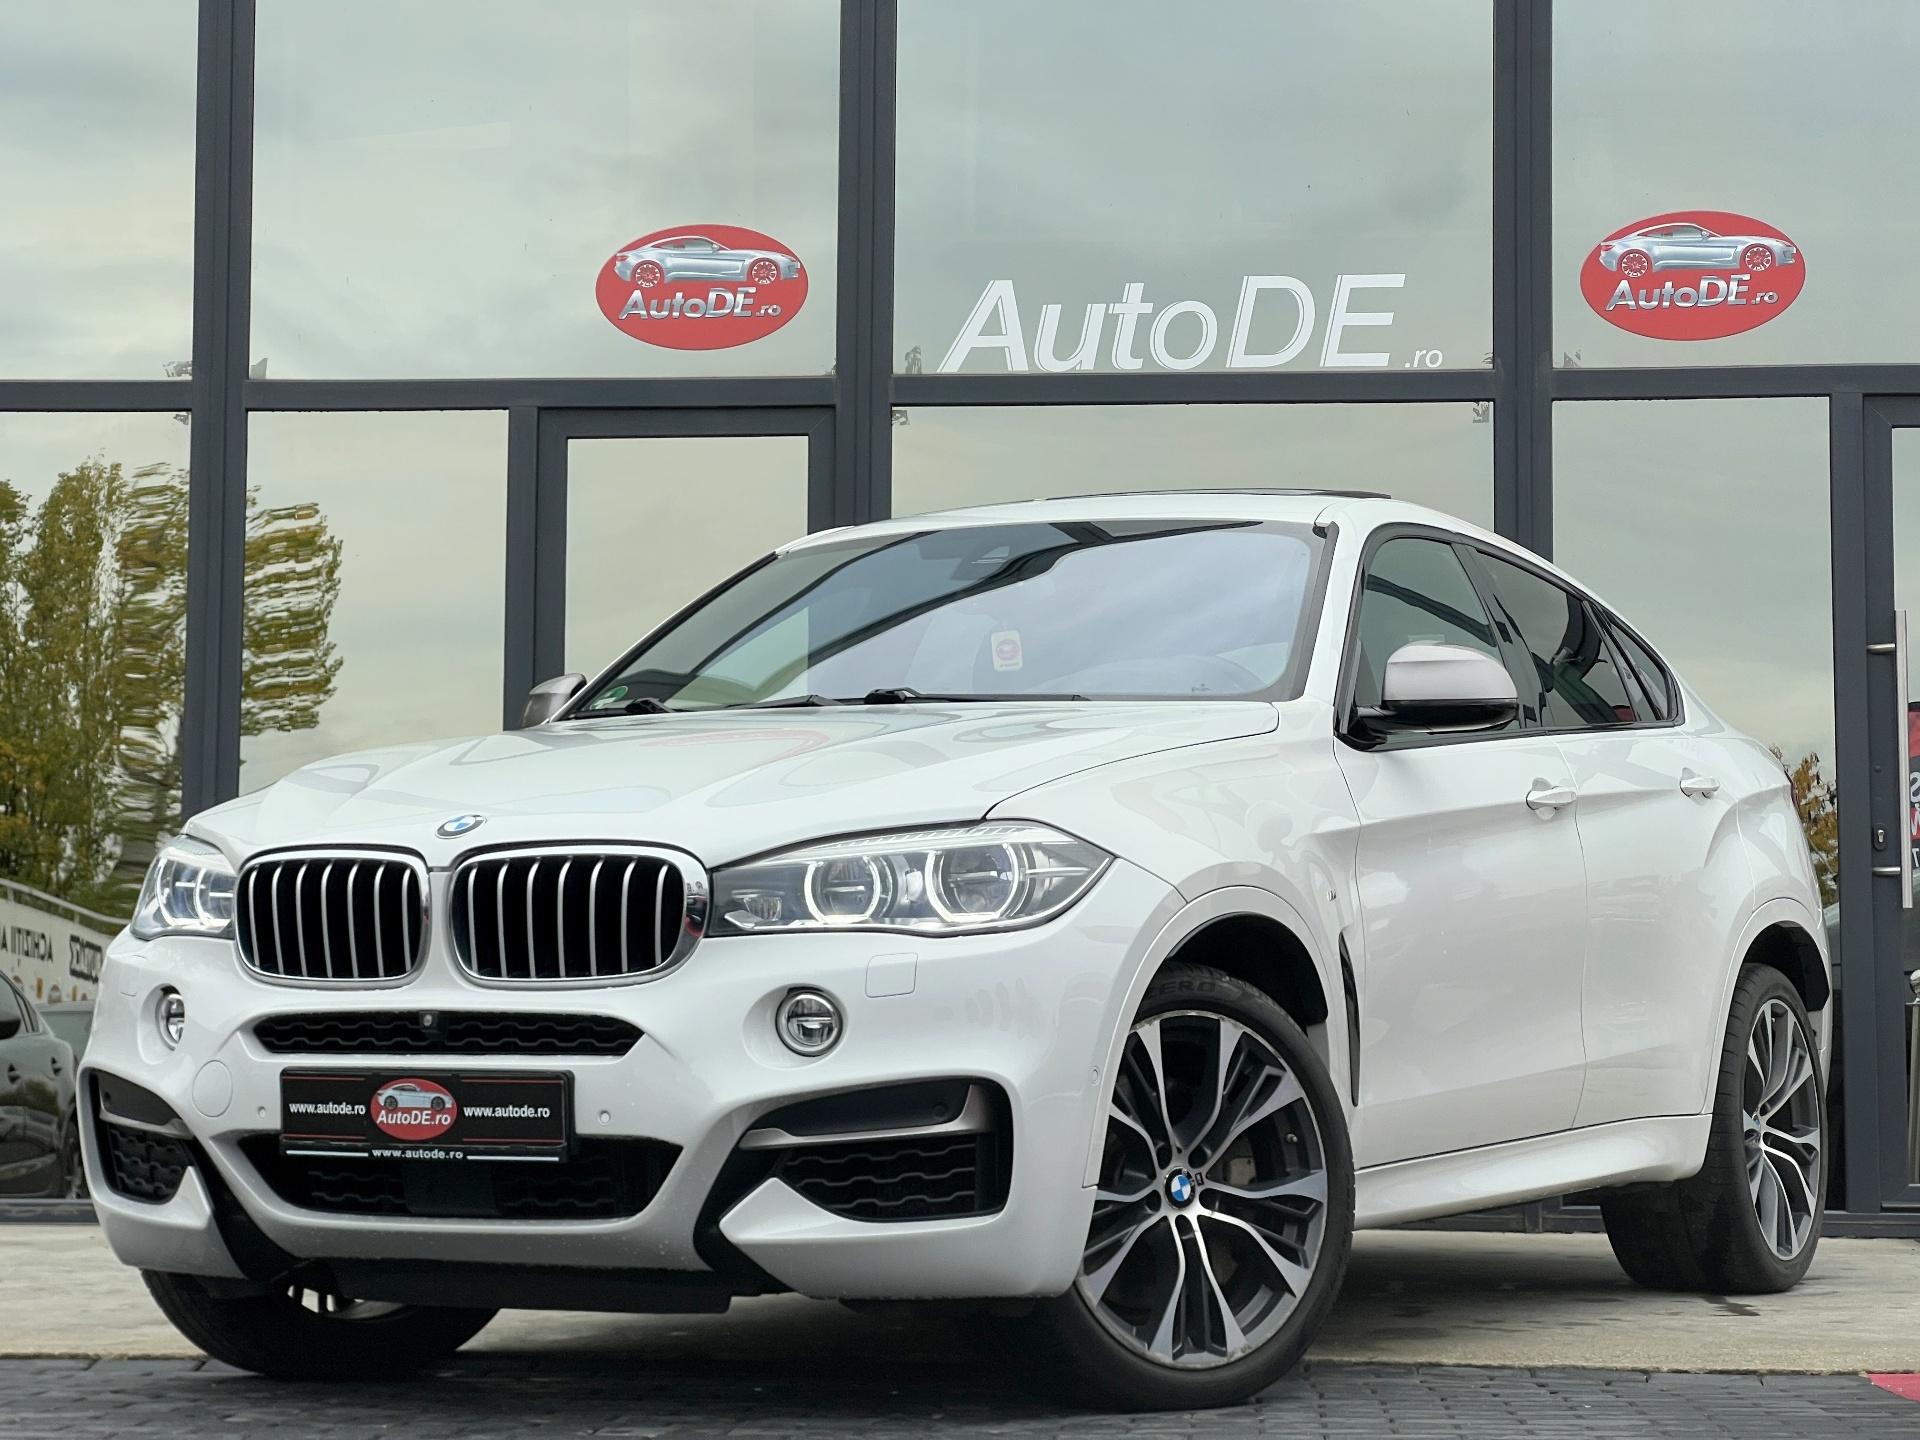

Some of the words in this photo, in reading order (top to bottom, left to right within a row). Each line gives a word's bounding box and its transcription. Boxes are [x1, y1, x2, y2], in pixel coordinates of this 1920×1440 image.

[289, 1101, 366, 1115] www.autode.ro
[463, 1104, 550, 1119] www.autode.ro
[376, 1109, 452, 1126] AutoDE.ro
[372, 1147, 464, 1160] www.autode.ro
